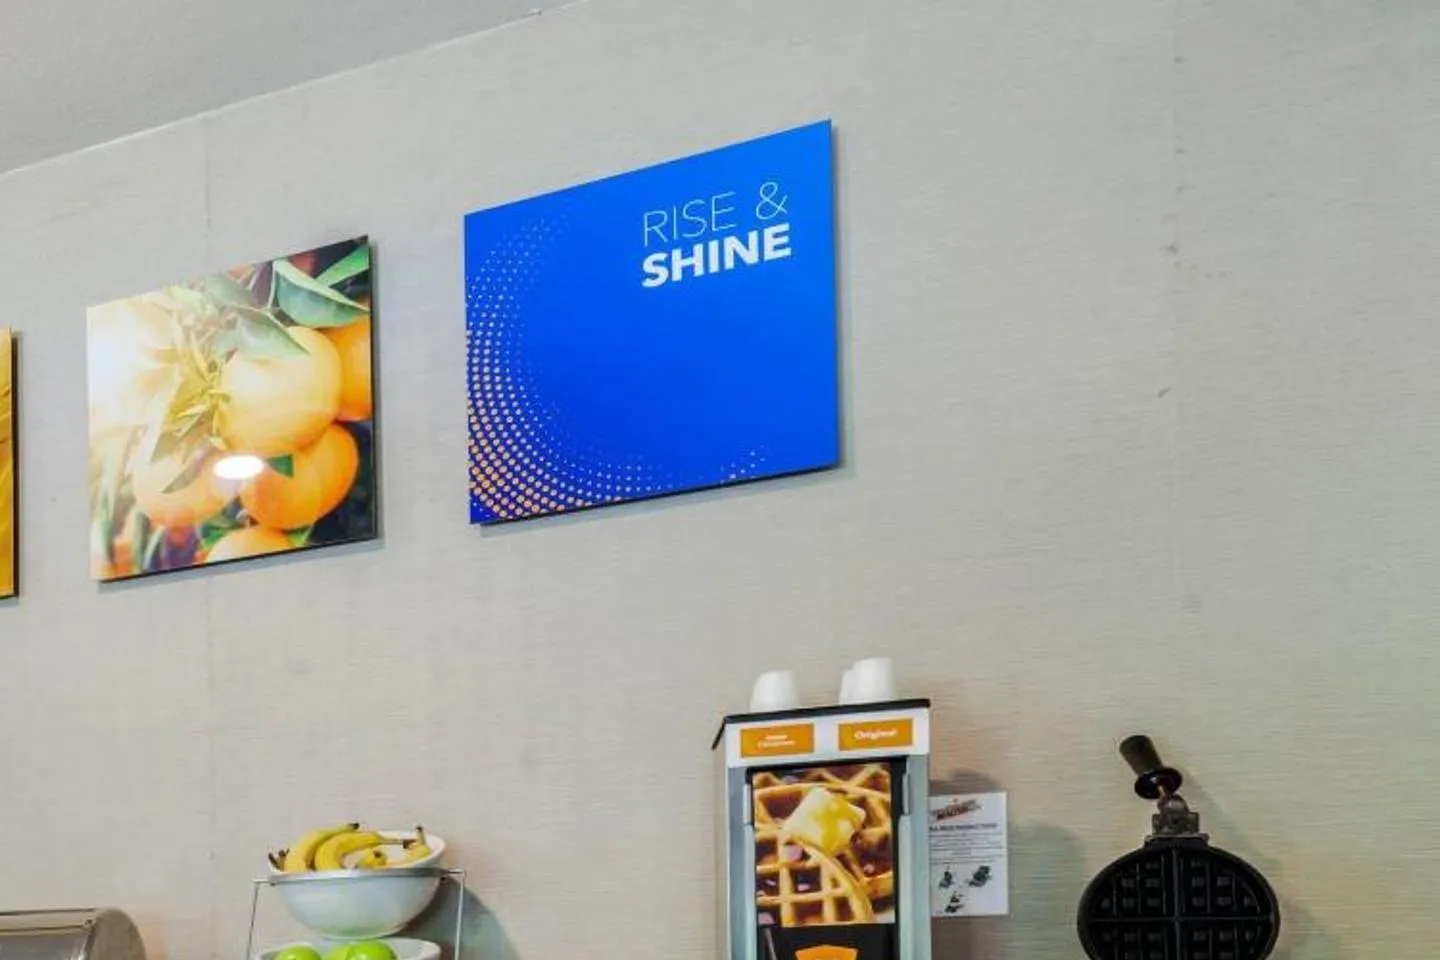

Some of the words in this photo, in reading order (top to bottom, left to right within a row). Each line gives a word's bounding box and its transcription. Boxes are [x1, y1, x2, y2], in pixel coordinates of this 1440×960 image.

[643, 191, 737, 247] RISE
[756, 181, 788, 220] &
[641, 223, 792, 288] SHINE
[854, 729, 898, 741] Original
